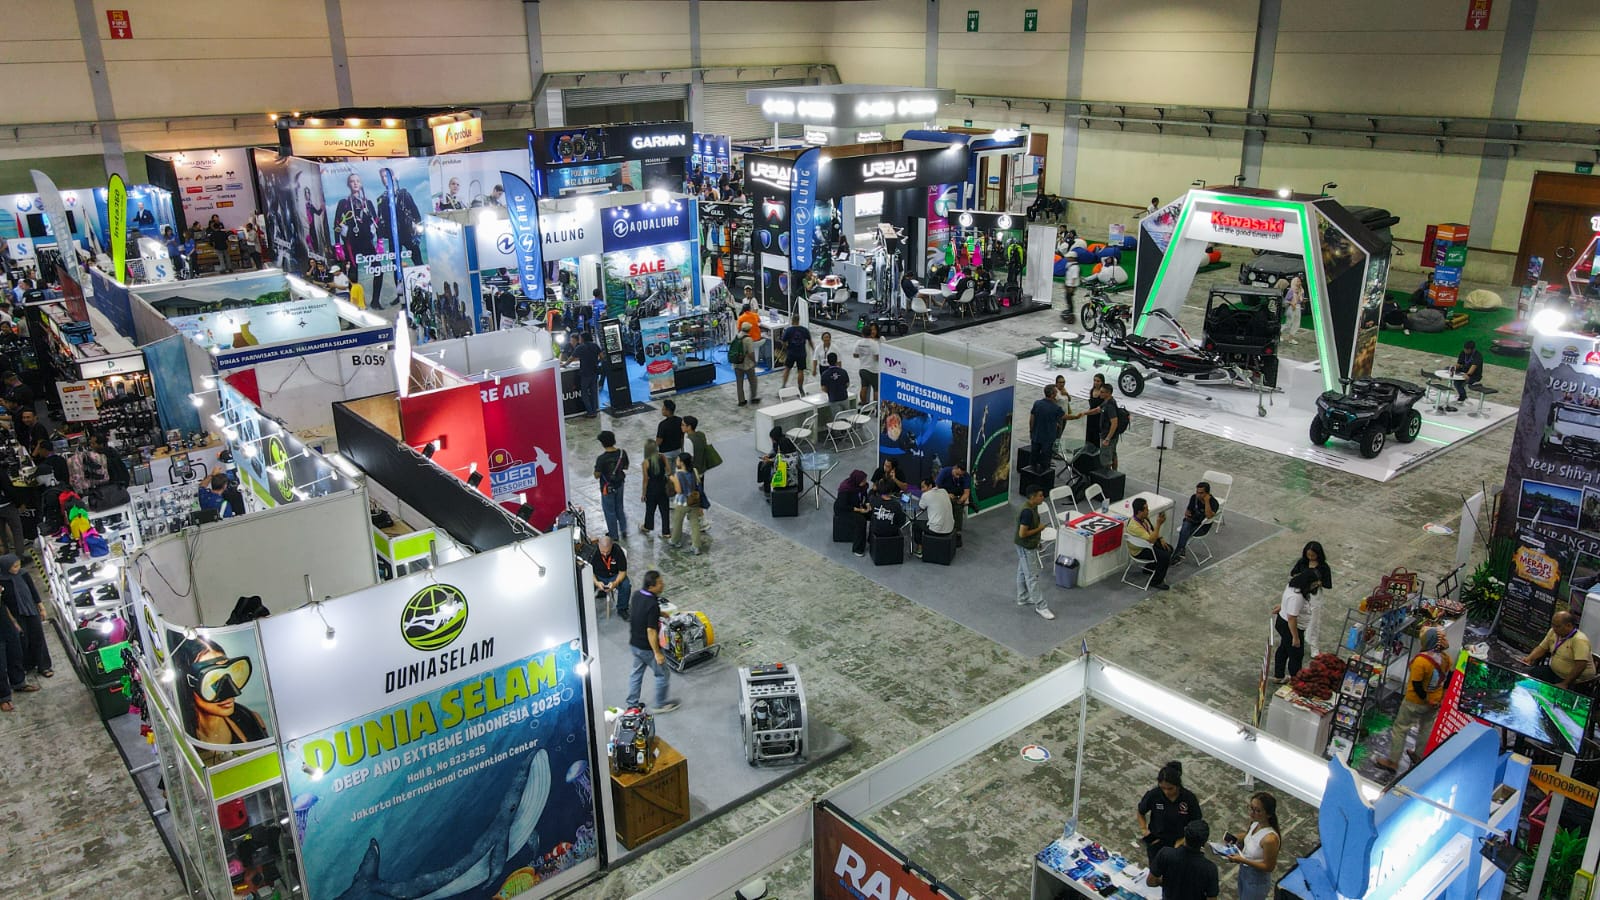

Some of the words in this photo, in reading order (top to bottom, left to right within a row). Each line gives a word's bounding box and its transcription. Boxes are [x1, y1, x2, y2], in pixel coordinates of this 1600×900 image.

[344, 139, 375, 147] DIVING
[631, 134, 686, 150] GARMIN
[863, 158, 917, 177] URBAN
[797, 169, 810, 204] LUNG
[514, 193, 532, 232] LUNG
[1211, 210, 1285, 233] Kawasaki
[629, 216, 680, 232] AQUALUNG
[355, 249, 412, 267] Experiece
[629, 259, 666, 276] SALE
[219, 357, 240, 366] DINAS
[241, 351, 279, 363] PARIWISATA
[296, 342, 333, 353] HALMAHERA
[332, 337, 358, 347] SELATAN
[352, 354, 385, 366] B.059
[503, 381, 530, 399] AIR
[1546, 375, 1578, 393] Jeep
[1581, 381, 1600, 397] La
[1527, 457, 1555, 475] Jeep
[1519, 556, 1553, 573] MERAPI
[385, 637, 494, 694] DUNIASELAM
[302, 700, 440, 777] DUNIA
[440, 652, 559, 730] SELAM
[333, 772, 370, 793] DEEP
[373, 758, 401, 778] AND
[404, 732, 464, 767] EXTREME
[465, 707, 530, 741] INDONESIA
[531, 691, 561, 716] 2025
[351, 799, 392, 823] Jakarta
[392, 774, 457, 808] International
[457, 746, 509, 778] Convention
[509, 737, 539, 759] Center
[407, 772, 425, 784] Hall
[437, 759, 449, 772] No
[834, 843, 916, 900] RA
